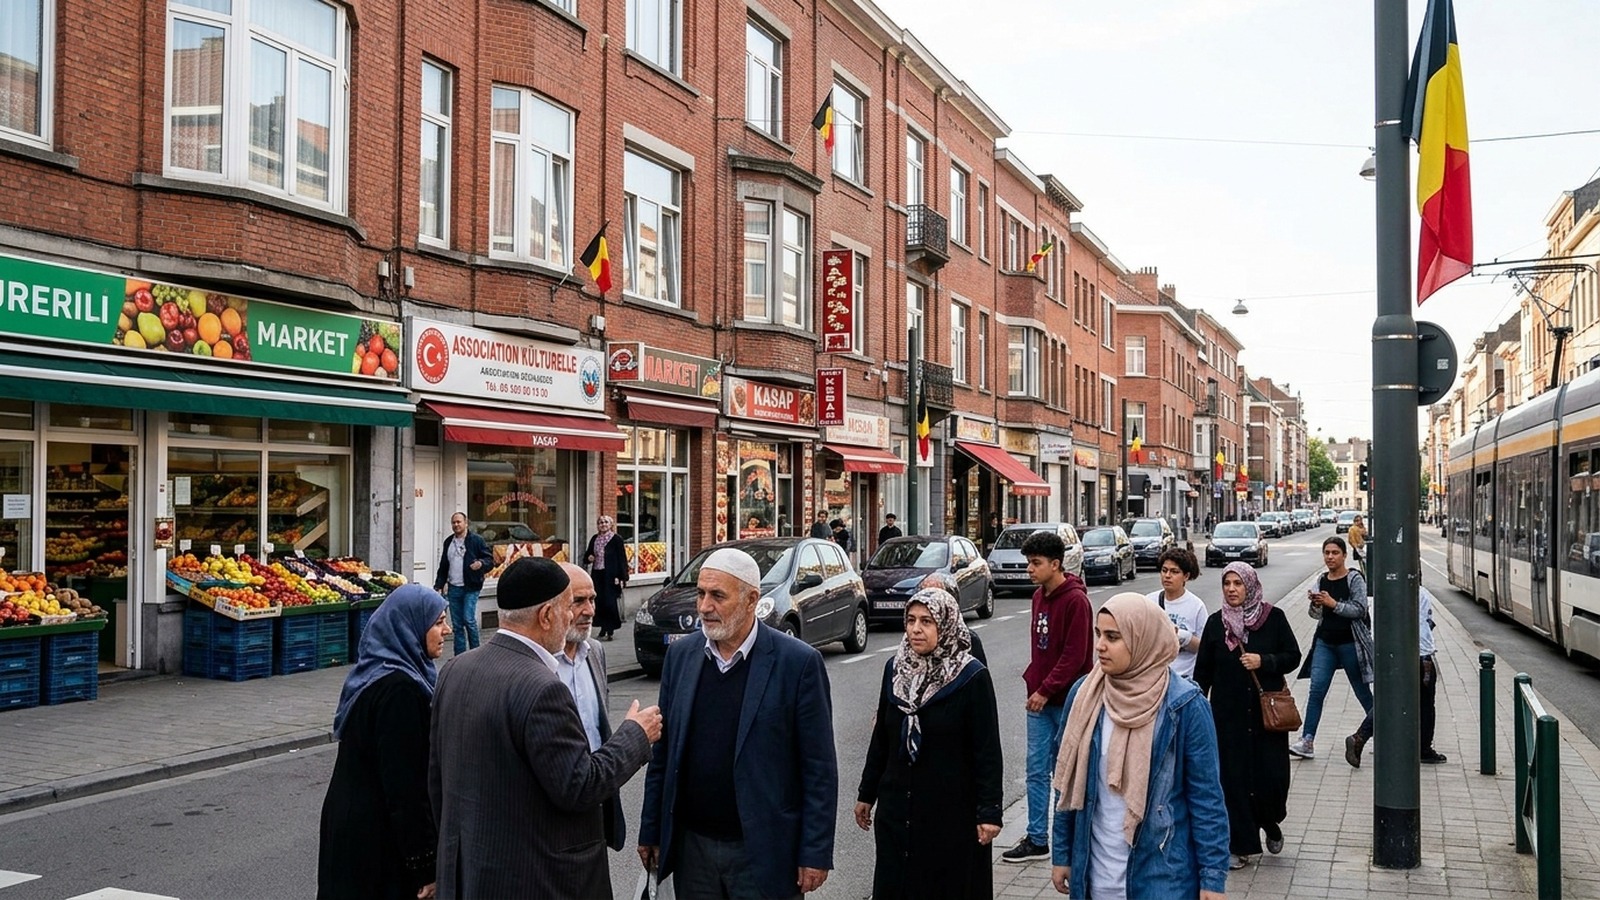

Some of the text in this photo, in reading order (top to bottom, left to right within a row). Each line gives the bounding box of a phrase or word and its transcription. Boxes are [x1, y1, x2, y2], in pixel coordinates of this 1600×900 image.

[0, 279, 349, 357] RERILI MARKET
[452, 335, 519, 364] ASSOCIATION
[521, 345, 577, 374] KÜLTURELLE
[753, 385, 794, 410] KASAP
